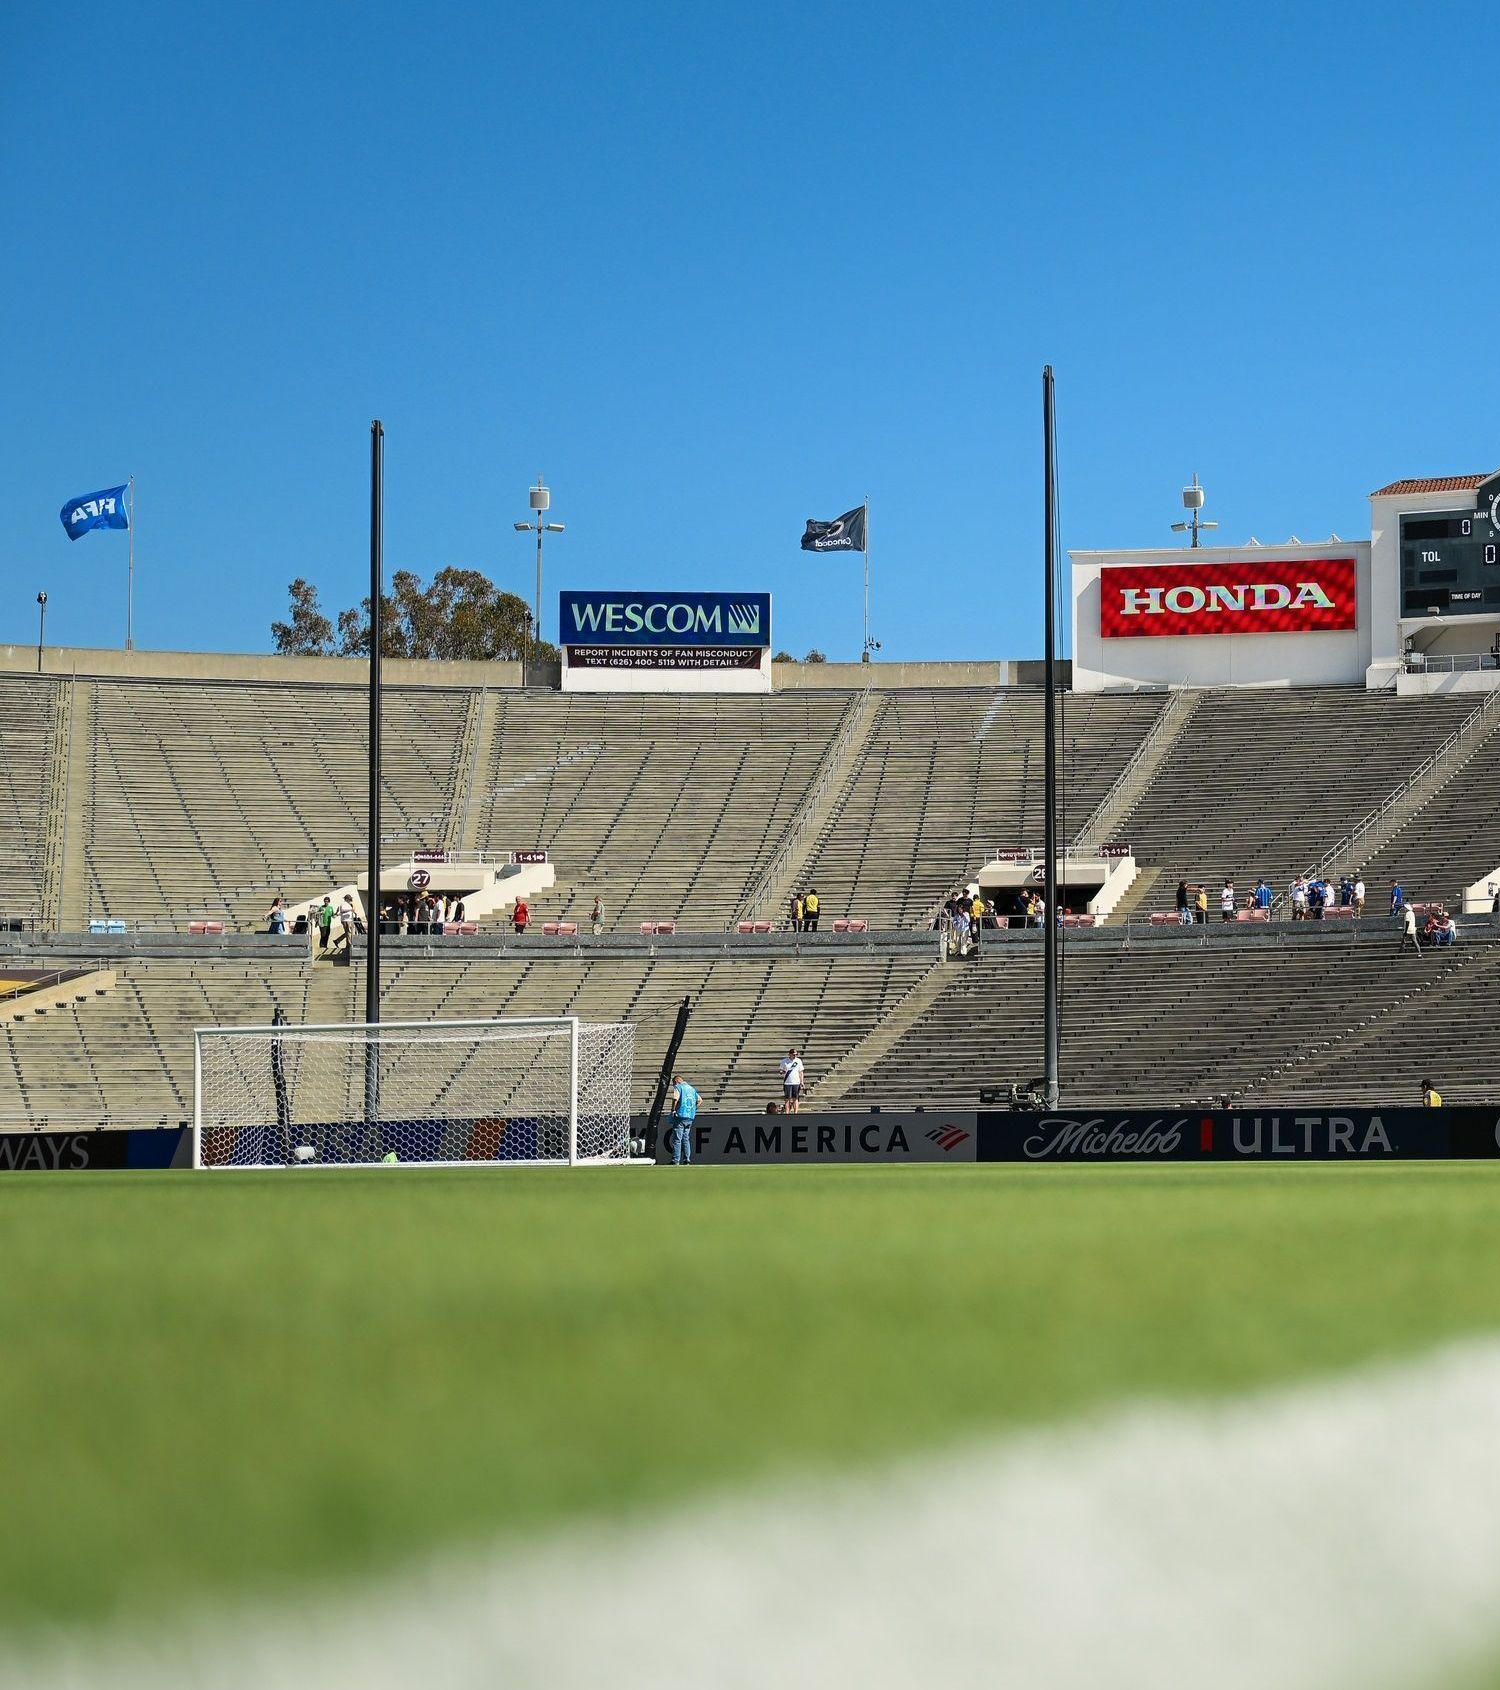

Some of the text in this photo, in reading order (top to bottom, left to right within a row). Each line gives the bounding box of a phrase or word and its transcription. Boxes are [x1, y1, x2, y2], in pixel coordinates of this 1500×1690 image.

[1473, 511, 1489, 519] MIN
[1422, 551, 1441, 562] TOL
[1119, 582, 1336, 615] HONDA
[1471, 592, 1481, 600] DAY
[571, 603, 722, 633] WESCOM
[611, 649, 659, 657] INCIDENTS
[695, 650, 754, 658] MISCONDUCT
[585, 657, 739, 666] TEXT (626) 400- 5119 WITH DETAILS
[412, 873, 429, 884] 27
[723, 1124, 911, 1154] AMERICA
[1022, 1116, 1394, 1158] Michelob ULTRA
